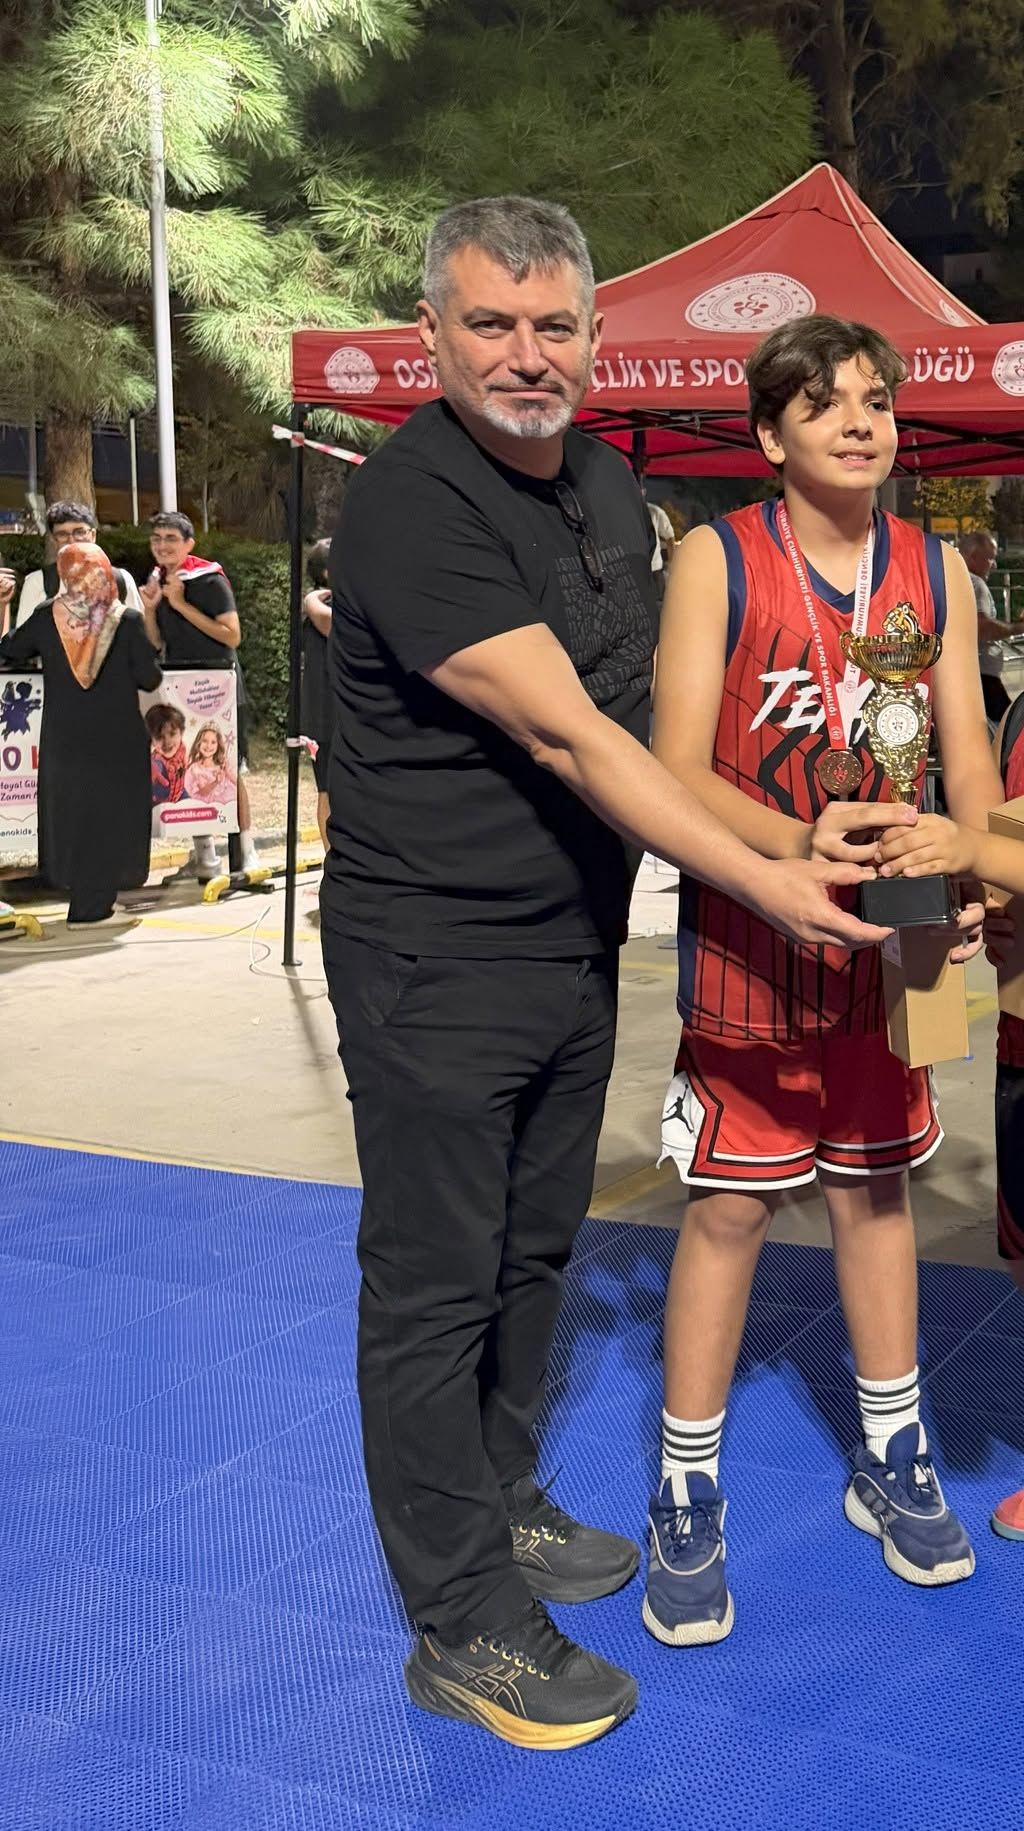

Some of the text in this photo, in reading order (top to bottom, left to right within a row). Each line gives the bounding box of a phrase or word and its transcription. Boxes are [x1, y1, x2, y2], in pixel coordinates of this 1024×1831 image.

[591, 352, 646, 392] ÇLİK
[647, 359, 685, 388] VE
[690, 358, 749, 387] SPO
[906, 346, 975, 383] ÜĞÜ
[787, 540, 809, 593] CUMHURİYETİ
[814, 632, 822, 643] VE
[817, 644, 827, 668] SPOR
[821, 669, 837, 717] BAKANLIĞI
